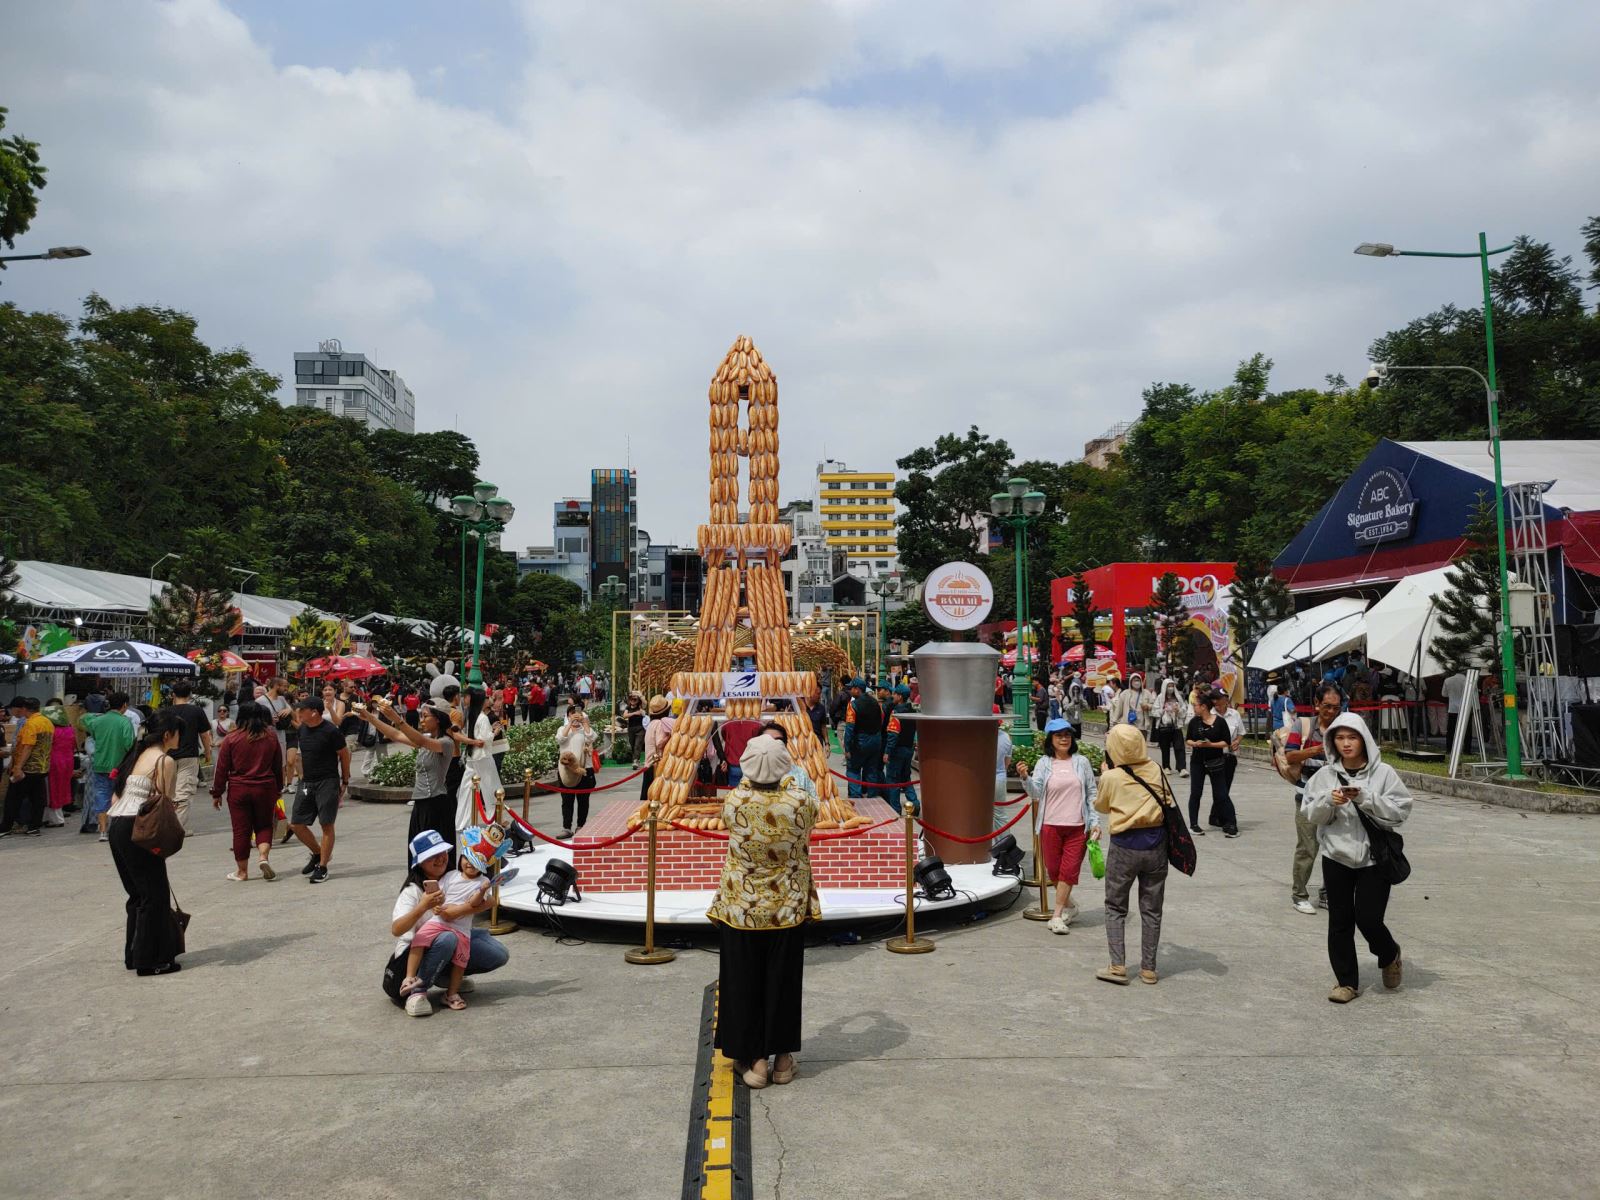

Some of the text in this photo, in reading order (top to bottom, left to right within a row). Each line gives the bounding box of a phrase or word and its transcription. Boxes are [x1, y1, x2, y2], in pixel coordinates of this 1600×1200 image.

[1370, 486, 1390, 503] ABC
[1347, 502, 1414, 528] Signature Bakery
[940, 596, 964, 605] BÁNH
